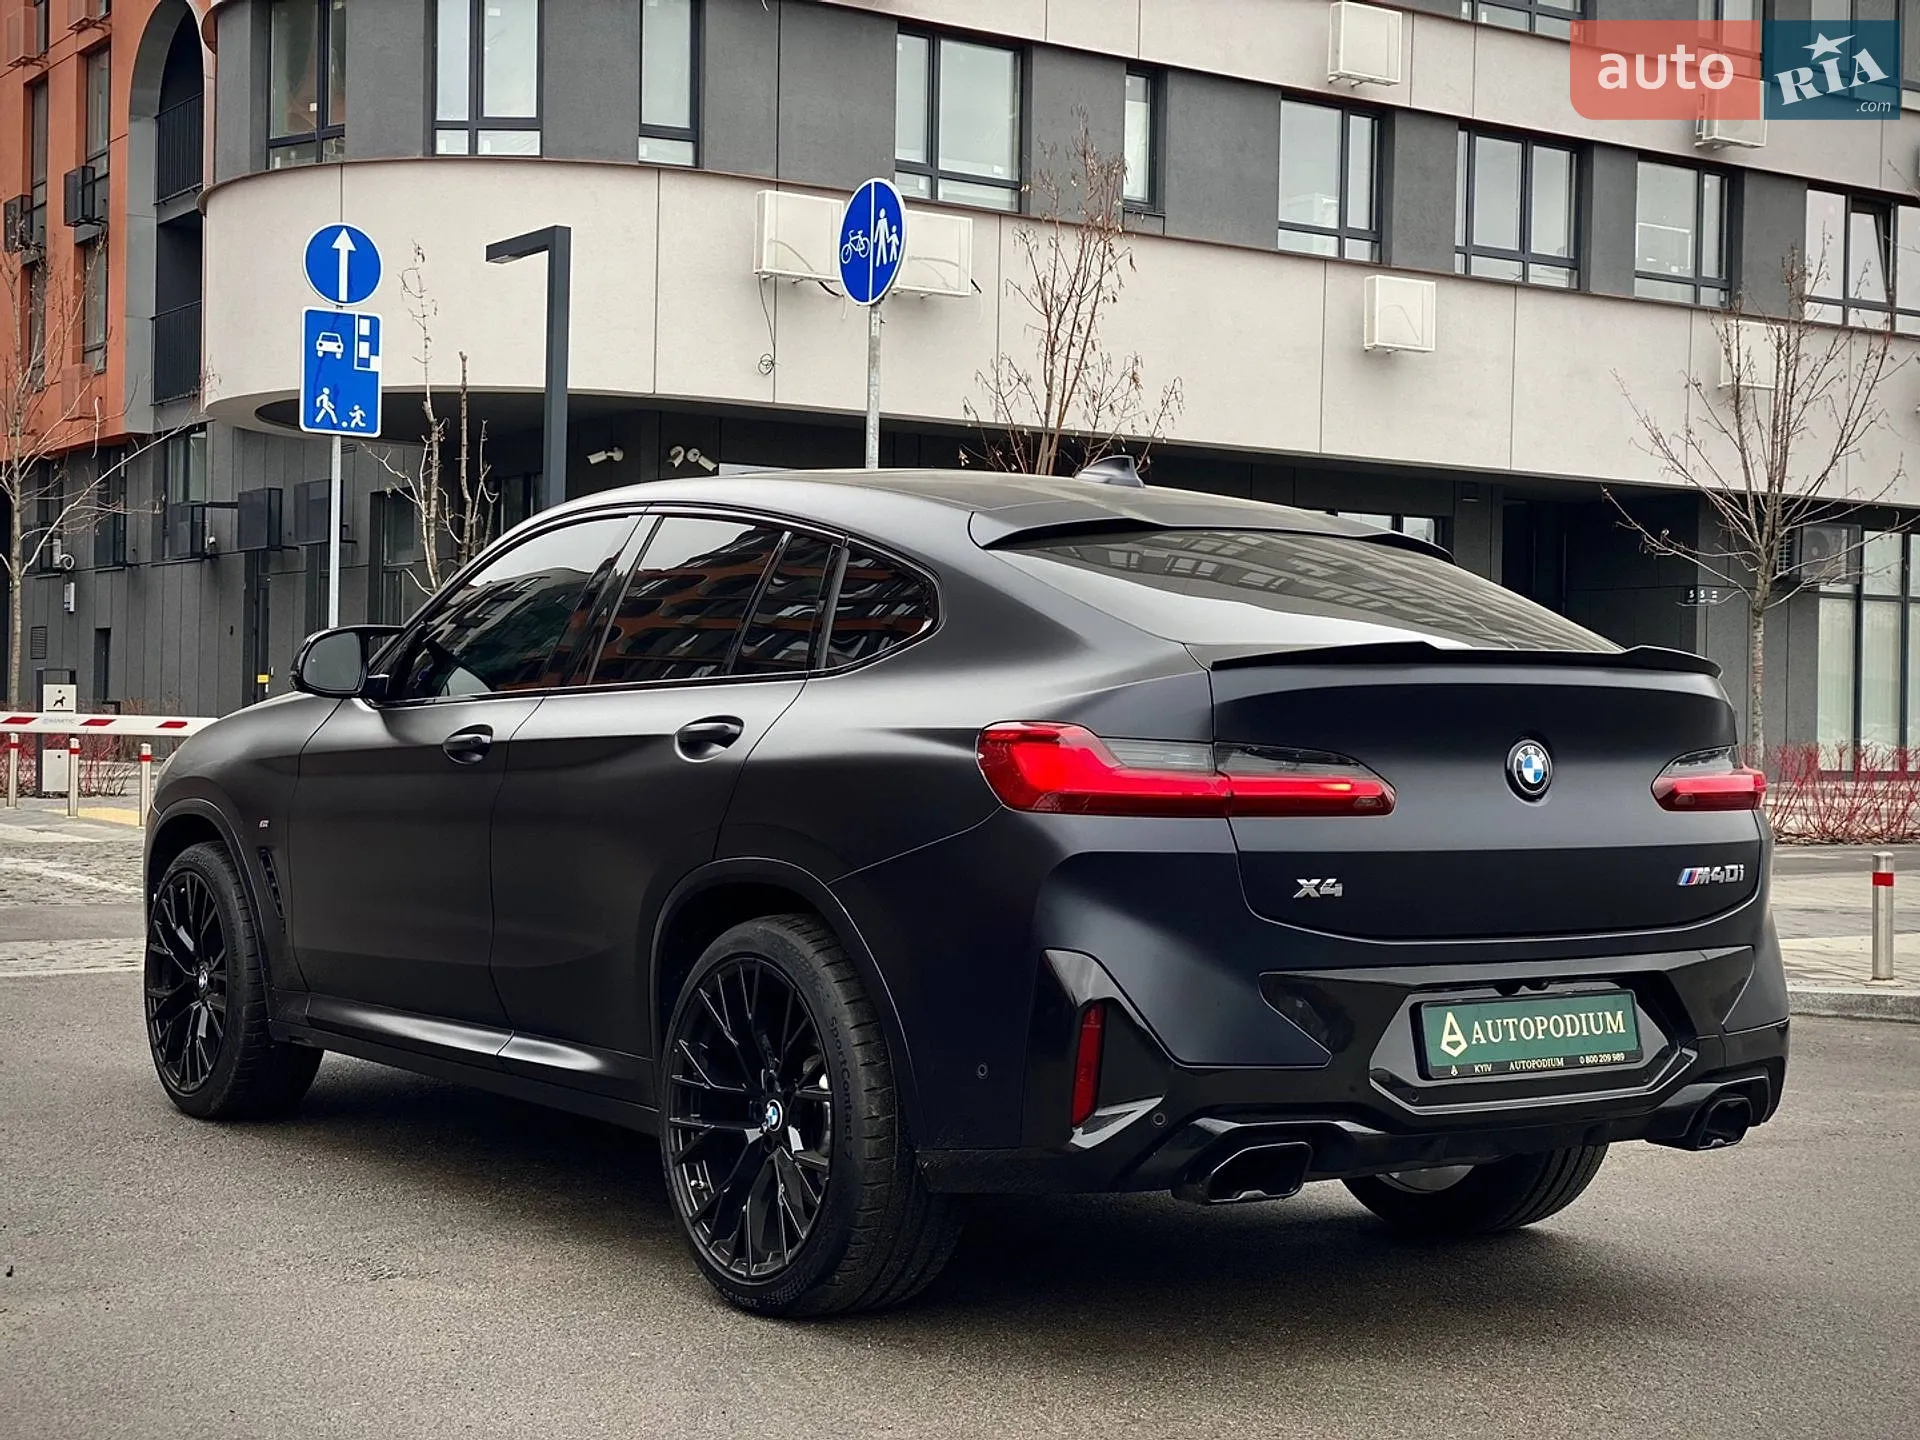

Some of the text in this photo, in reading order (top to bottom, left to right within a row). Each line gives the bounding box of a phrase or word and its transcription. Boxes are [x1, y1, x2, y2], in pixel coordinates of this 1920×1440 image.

[1293, 878, 1343, 899] X4
[1471, 1010, 1626, 1045] AUTOPODIUM
[1474, 1063, 1492, 1073] KYIV
[1509, 1057, 1564, 1071] AUTOPODIUM
